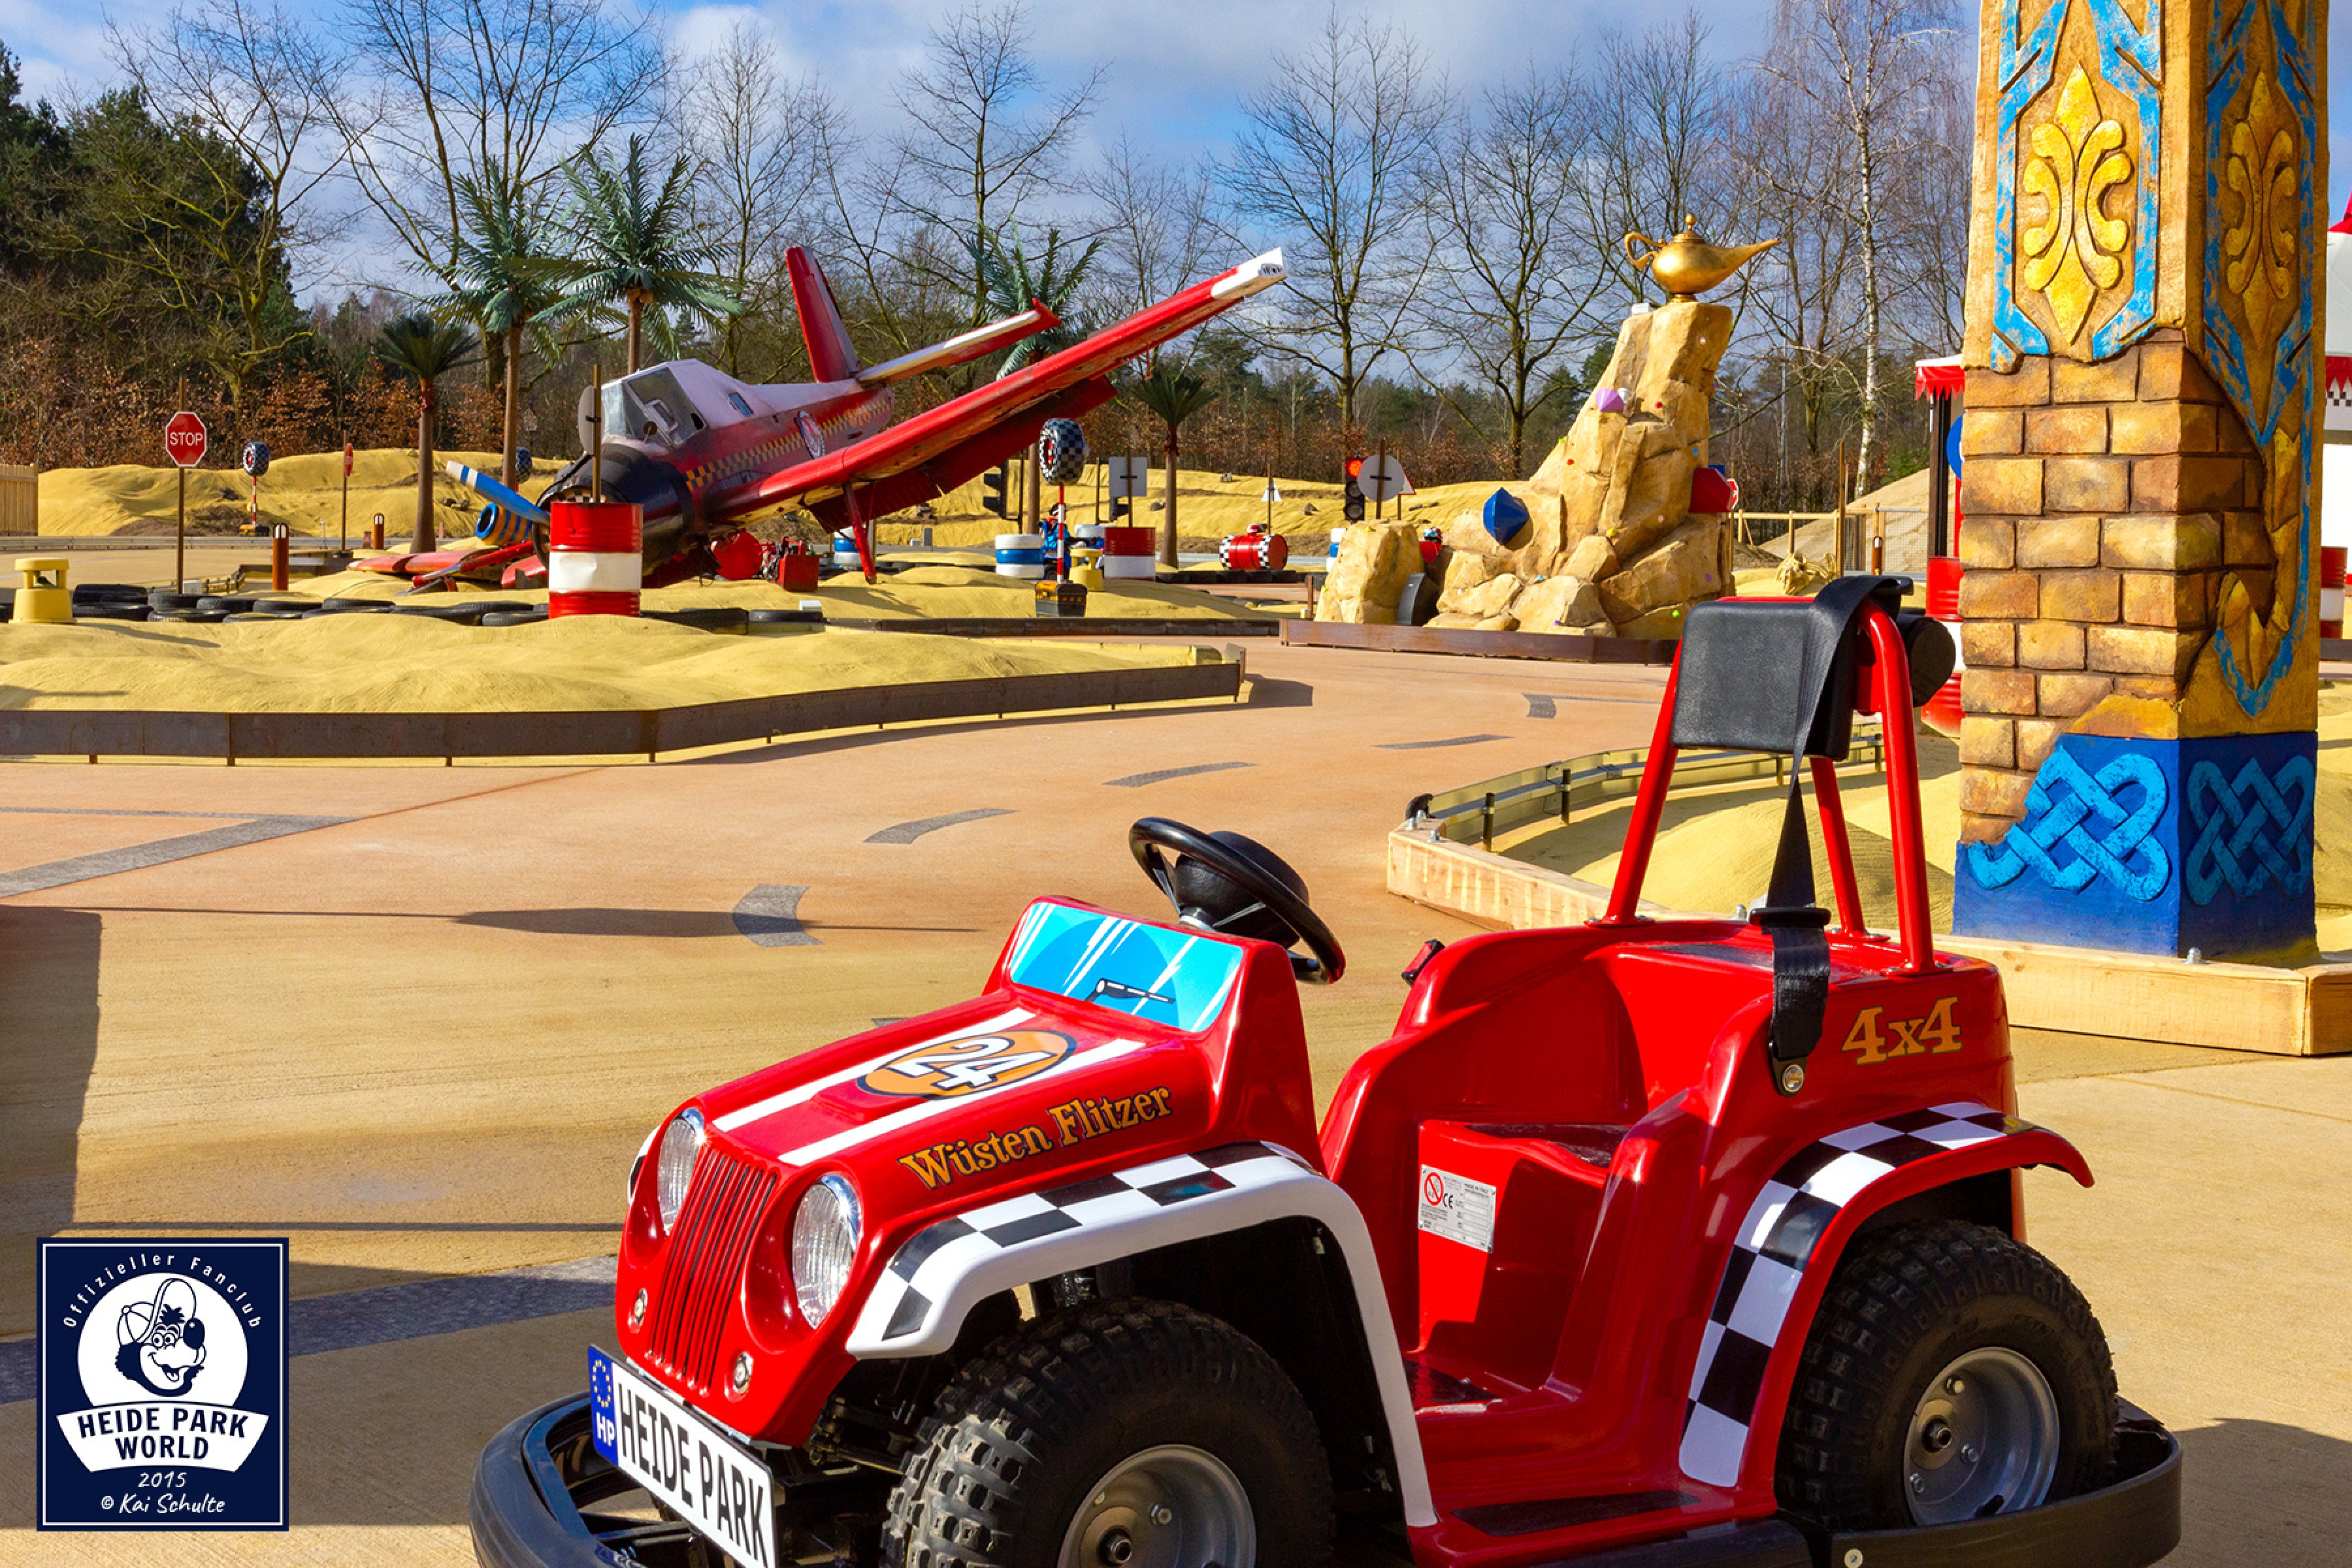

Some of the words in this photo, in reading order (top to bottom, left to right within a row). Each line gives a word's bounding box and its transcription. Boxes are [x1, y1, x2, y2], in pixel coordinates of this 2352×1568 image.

[170, 432, 203, 446] STOP
[1842, 996, 1962, 1066] 4x4
[887, 1036, 1058, 1090] 24
[898, 1126, 1054, 1190] Wüsten
[1047, 1086, 1173, 1148] Flitzer
[596, 1412, 615, 1446] HP
[618, 1382, 693, 1508] HEIDE
[699, 1439, 769, 1568] PARK
